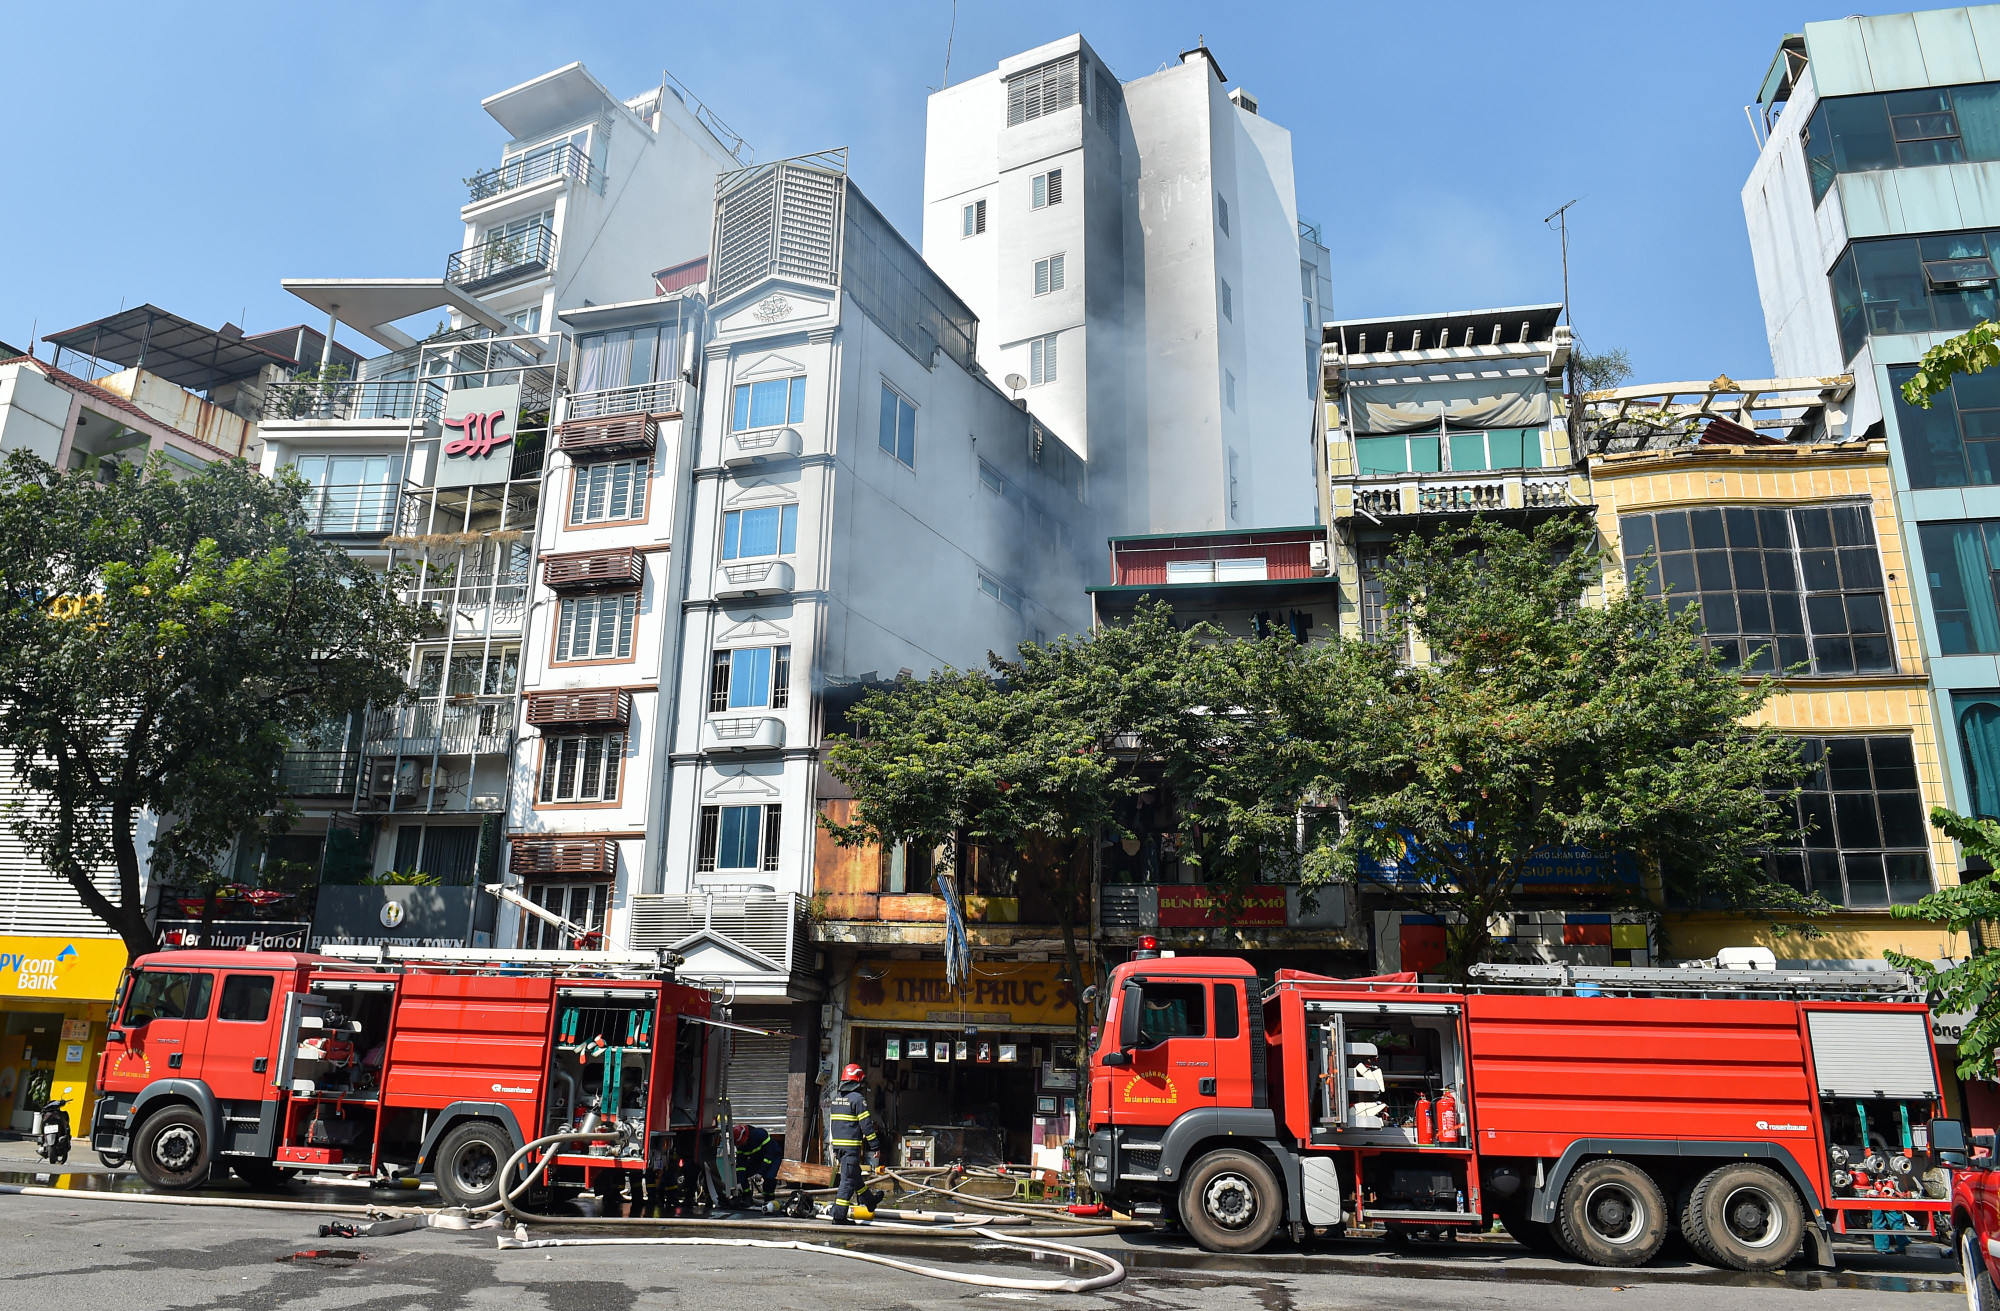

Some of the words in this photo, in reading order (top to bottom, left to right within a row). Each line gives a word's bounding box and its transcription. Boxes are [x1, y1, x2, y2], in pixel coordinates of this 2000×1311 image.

[1556, 862, 1592, 877] PHÁP
[1160, 896, 1192, 909] BÚN
[251, 931, 303, 948] Hanoi
[422, 937, 465, 949] TOWN
[0, 953, 55, 974] PVcom
[18, 973, 59, 990] Bank
